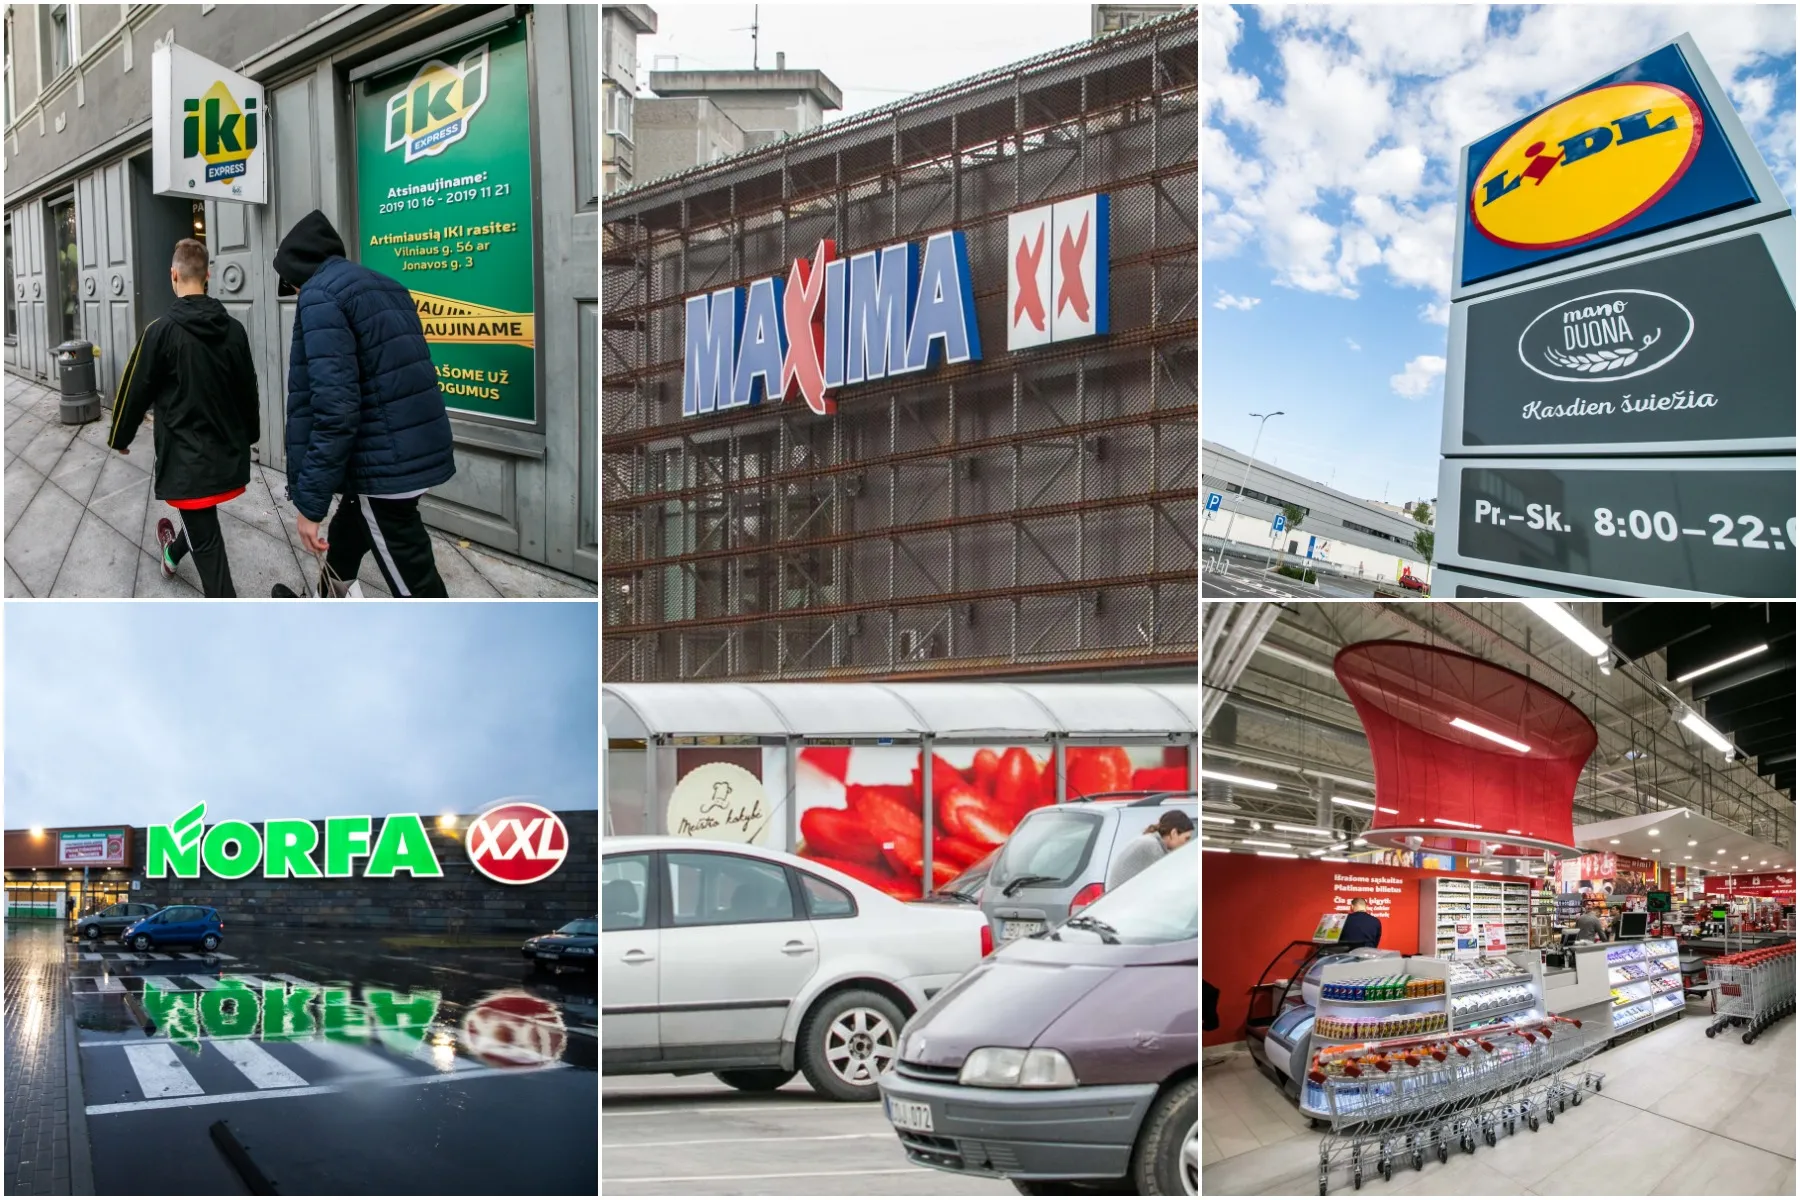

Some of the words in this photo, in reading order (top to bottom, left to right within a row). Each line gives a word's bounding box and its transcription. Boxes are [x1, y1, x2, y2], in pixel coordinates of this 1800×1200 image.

[390, 51, 483, 145] iki
[184, 97, 258, 159] iki
[414, 123, 459, 150] EXPRESS
[208, 162, 245, 178] EXPRESS
[379, 201, 404, 214] 2019
[407, 199, 419, 209] 10
[422, 196, 435, 207] 16
[446, 189, 477, 204] 2019
[480, 186, 491, 198] 11
[495, 183, 510, 196] 21
[388, 171, 488, 199] Atsinaujiname:
[369, 229, 441, 246] Artimiausią
[443, 226, 463, 239] IKI
[467, 222, 517, 236] rasite:
[394, 245, 439, 257] Vilniaus
[442, 246, 453, 257] g.
[456, 242, 473, 253] 56
[476, 241, 490, 251] ar
[402, 259, 448, 271] Jonavos
[451, 259, 462, 270] g.
[465, 257, 473, 267] 3
[683, 230, 981, 418] MAXIMA
[1563, 300, 1629, 323] mano
[424, 322, 523, 336] AUJINAME
[1563, 315, 1634, 350] DUONA
[435, 363, 485, 382] AŠOME
[487, 369, 510, 385] UŽ
[1522, 397, 1616, 420] Kasdien
[1620, 389, 1719, 414] šviežia
[147, 800, 444, 879] NORFA
[473, 818, 564, 861] XXL
